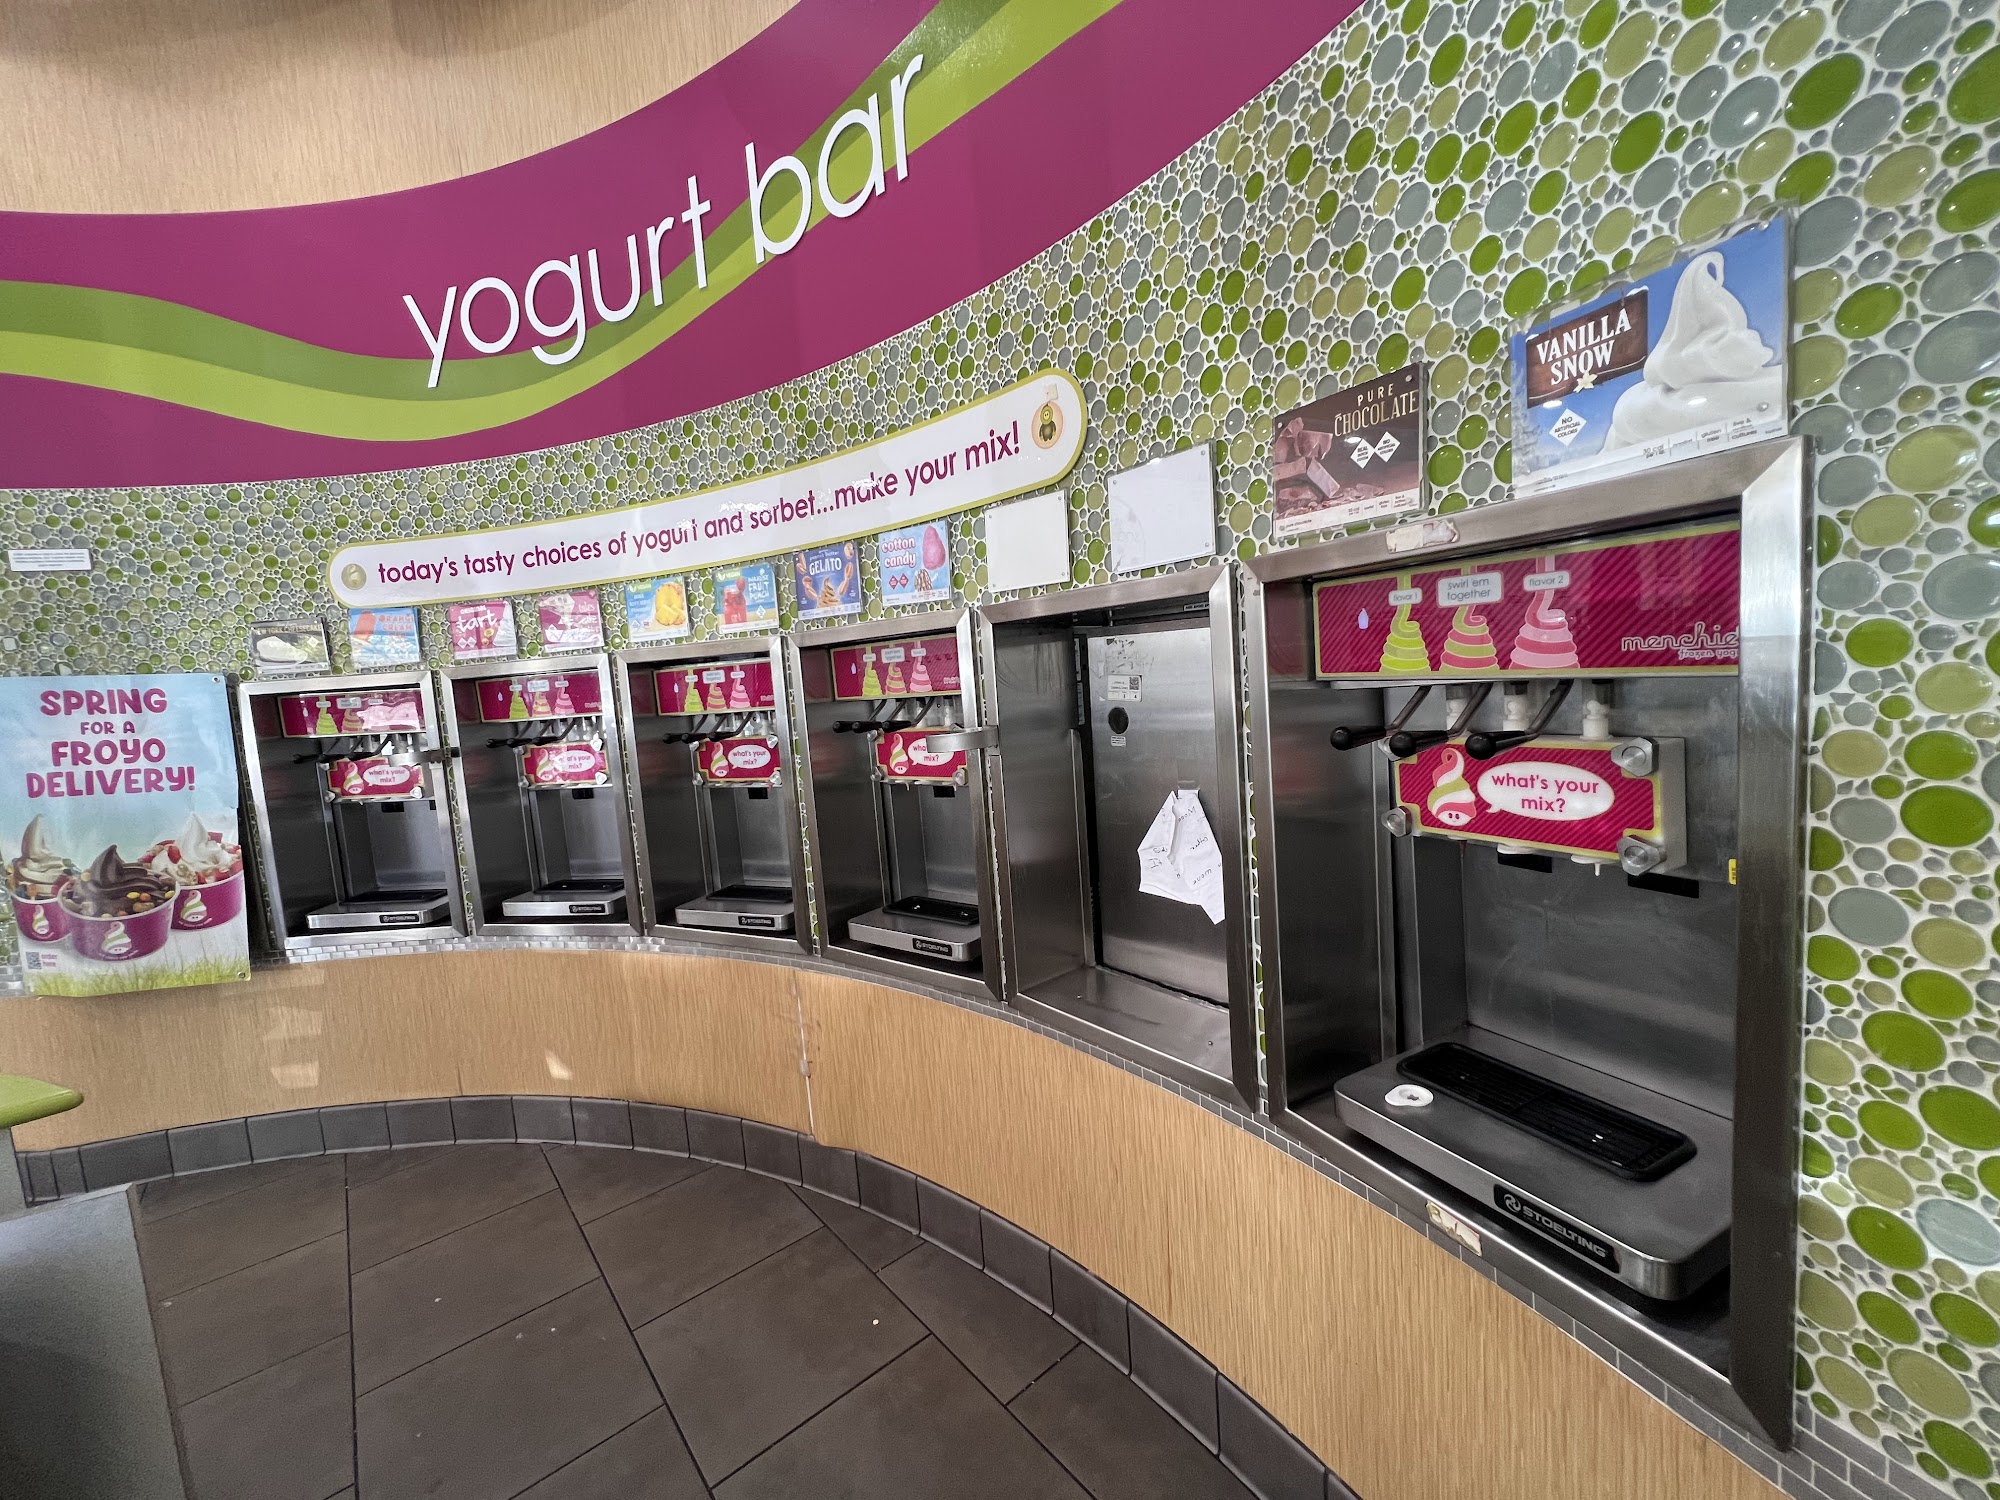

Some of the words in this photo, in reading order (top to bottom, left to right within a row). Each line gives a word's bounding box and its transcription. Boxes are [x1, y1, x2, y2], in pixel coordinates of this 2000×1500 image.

[402, 174, 711, 388] yogurt
[745, 53, 923, 263] bar
[1536, 308, 1632, 365] VANILLA
[1551, 339, 1615, 386] SNOW
[1357, 383, 1394, 407] PURE
[1334, 389, 1419, 437] CHOCOLATE
[1561, 416, 1573, 425] NO
[1554, 421, 1581, 433] ARTIFICIAL
[1557, 428, 1578, 438] COLORS
[378, 557, 459, 584] today's
[464, 550, 515, 576] tasty
[522, 541, 601, 568] choices
[608, 531, 627, 556] of
[704, 510, 743, 538] and
[905, 451, 957, 497] your
[965, 420, 1020, 471] mix!
[881, 537, 916, 553] cotton
[809, 557, 842, 576] GELATO
[884, 551, 917, 568] candy
[748, 582, 770, 592] FRUIT
[1447, 580, 1469, 590] swirl
[1529, 578, 1556, 587] flavor
[1558, 575, 1564, 584] 2
[1393, 592, 1413, 601] flavor
[1447, 588, 1492, 602] together
[456, 609, 498, 633] tart
[1678, 648, 1715, 660] frozen
[1715, 648, 1739, 659] yog
[40, 688, 167, 716] SPRING
[80, 721, 115, 735] FOR
[123, 720, 136, 734] A
[51, 738, 166, 767] FROYO
[913, 744, 927, 752] wha
[924, 754, 939, 762] mix?
[26, 766, 195, 798] DELIVERY!
[1491, 773, 1549, 790] what's
[1554, 779, 1599, 794] your
[1521, 796, 1566, 813] mix?
[1522, 1205, 1606, 1258] STOELTING
